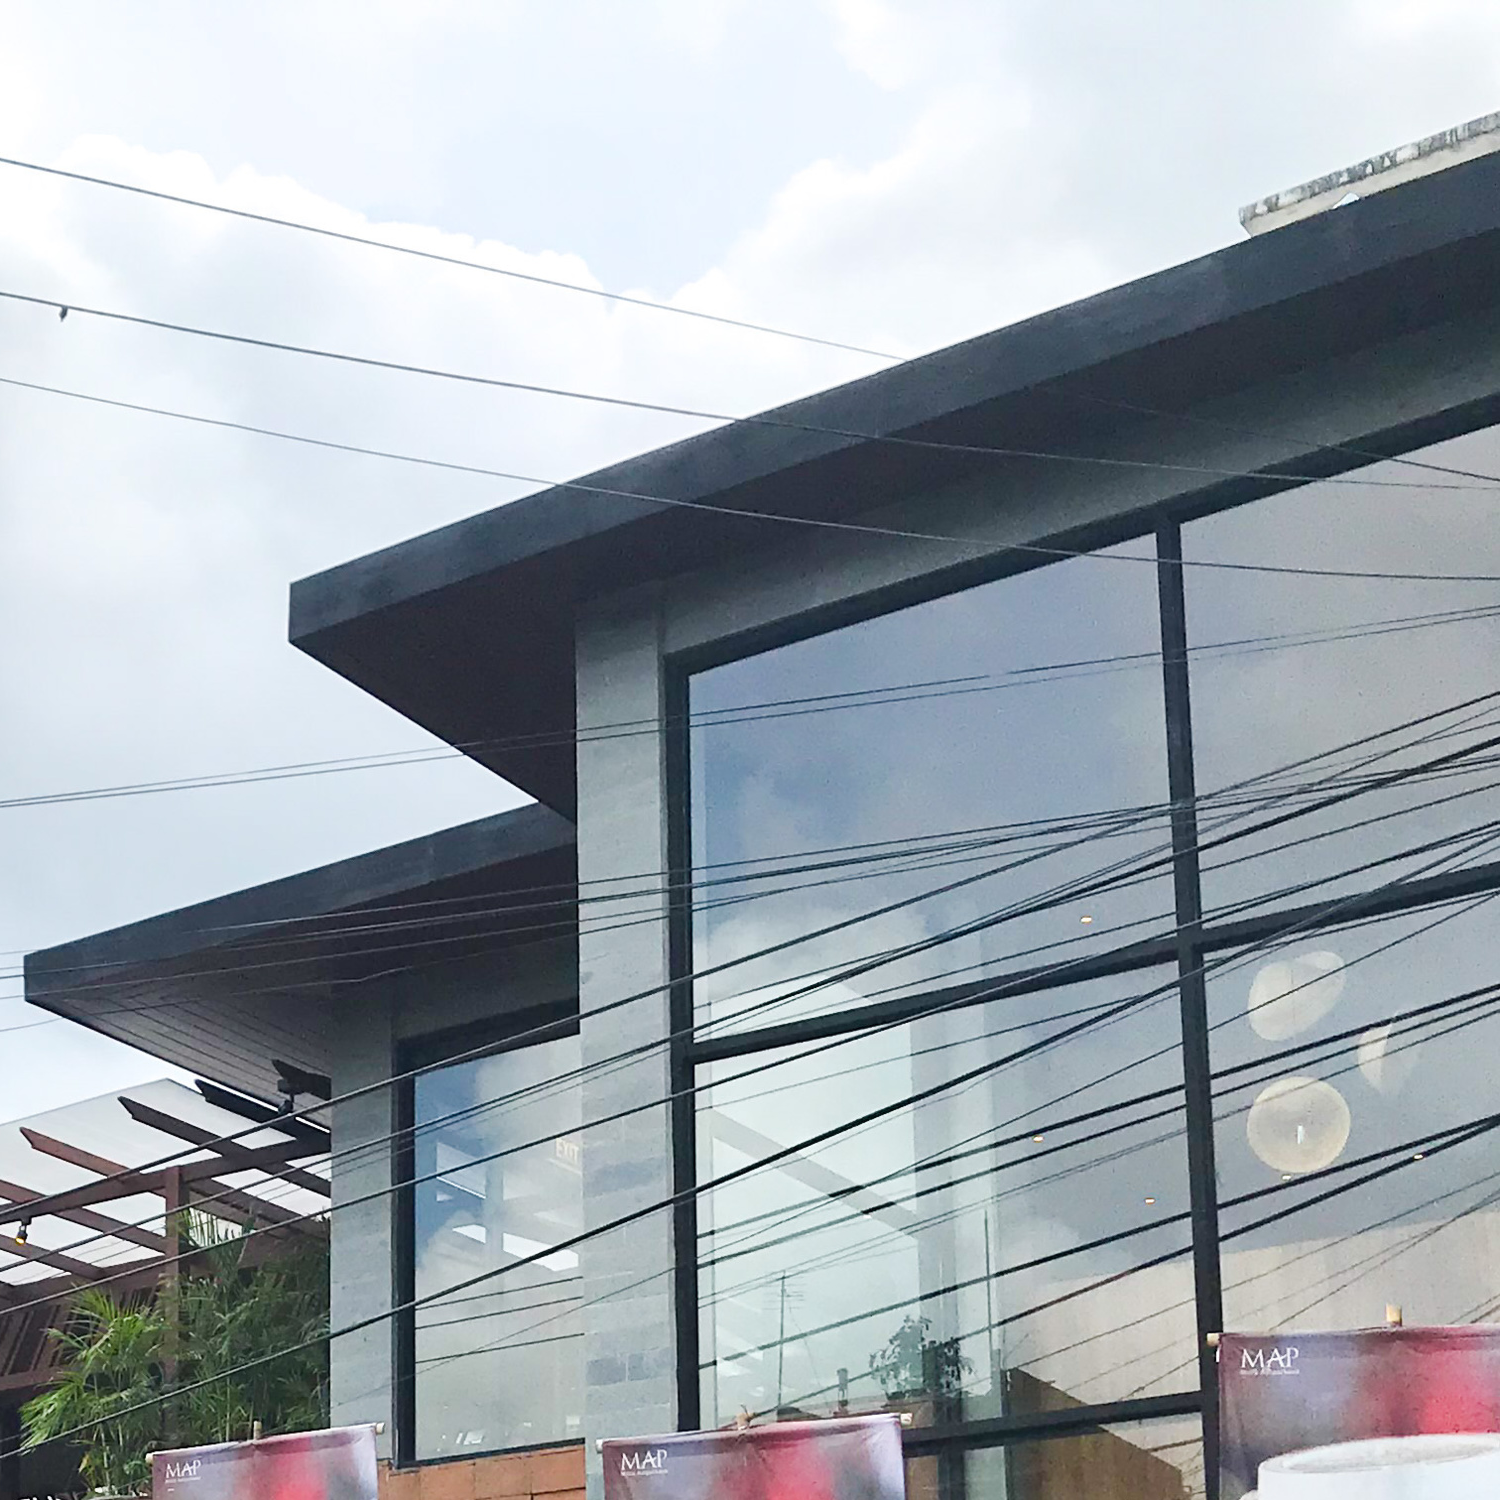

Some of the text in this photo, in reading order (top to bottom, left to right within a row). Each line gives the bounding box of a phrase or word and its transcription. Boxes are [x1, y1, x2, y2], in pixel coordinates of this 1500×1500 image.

[1241, 1347, 1299, 1368] MAP
[165, 1459, 202, 1479] MAP
[621, 1449, 668, 1471] MAP
